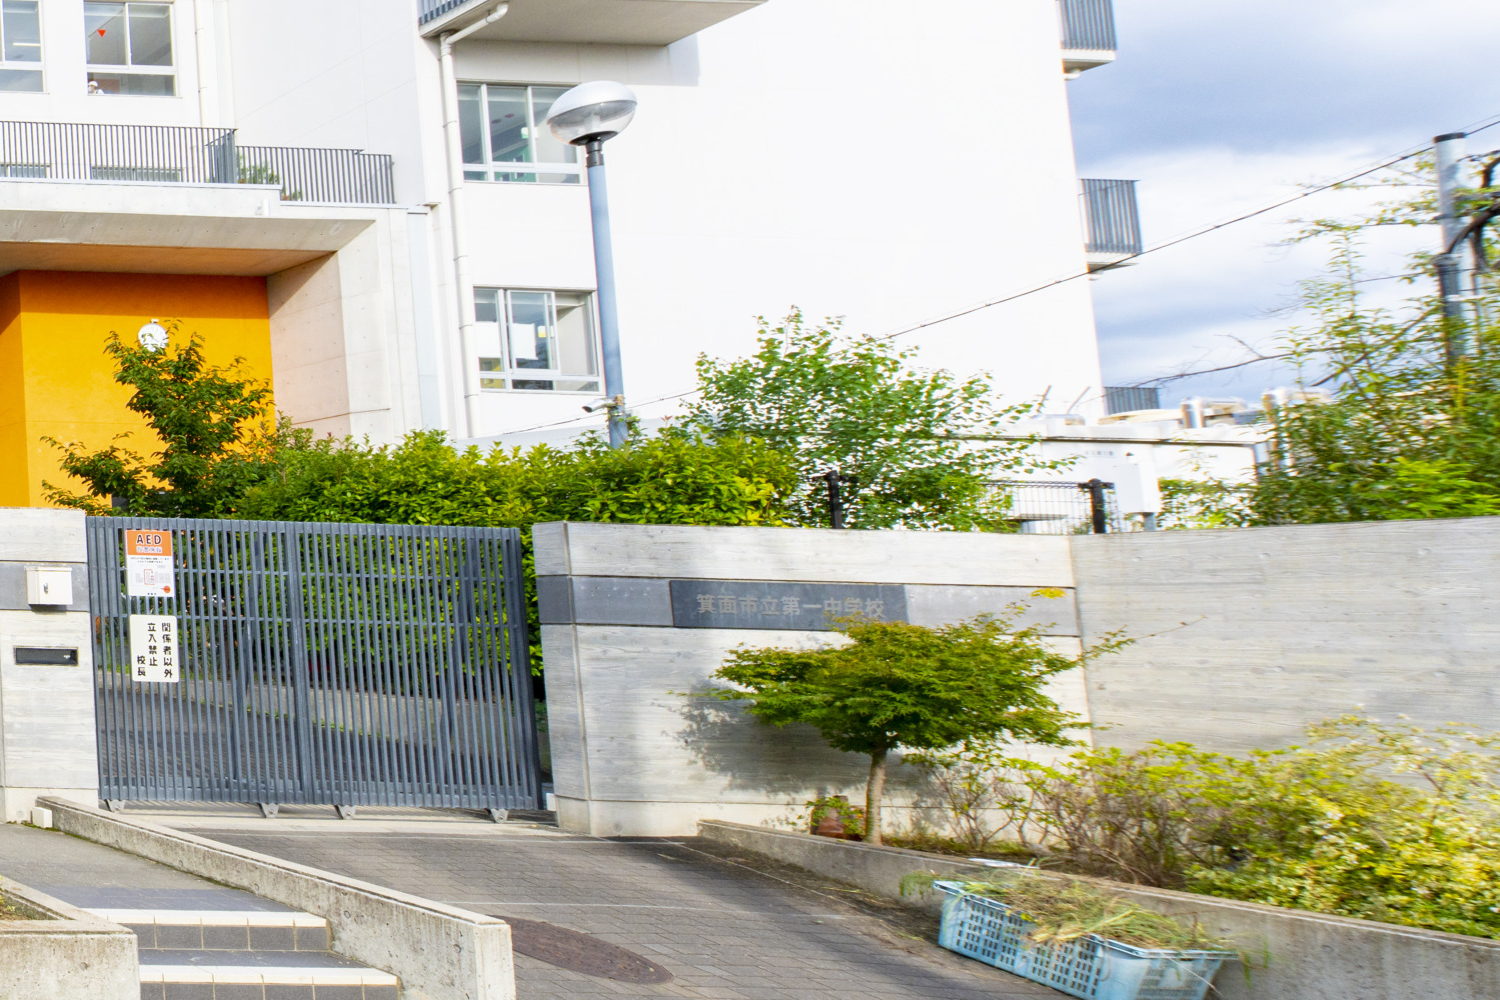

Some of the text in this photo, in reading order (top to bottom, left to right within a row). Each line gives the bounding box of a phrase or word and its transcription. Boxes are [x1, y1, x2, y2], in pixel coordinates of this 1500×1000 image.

[136, 534, 162, 545] AED
[696, 593, 886, 618] 箕面市立第一中学校
[147, 622, 158, 667] 立入禁止
[161, 622, 173, 679] 関係者以外
[136, 655, 146, 677] 校長
